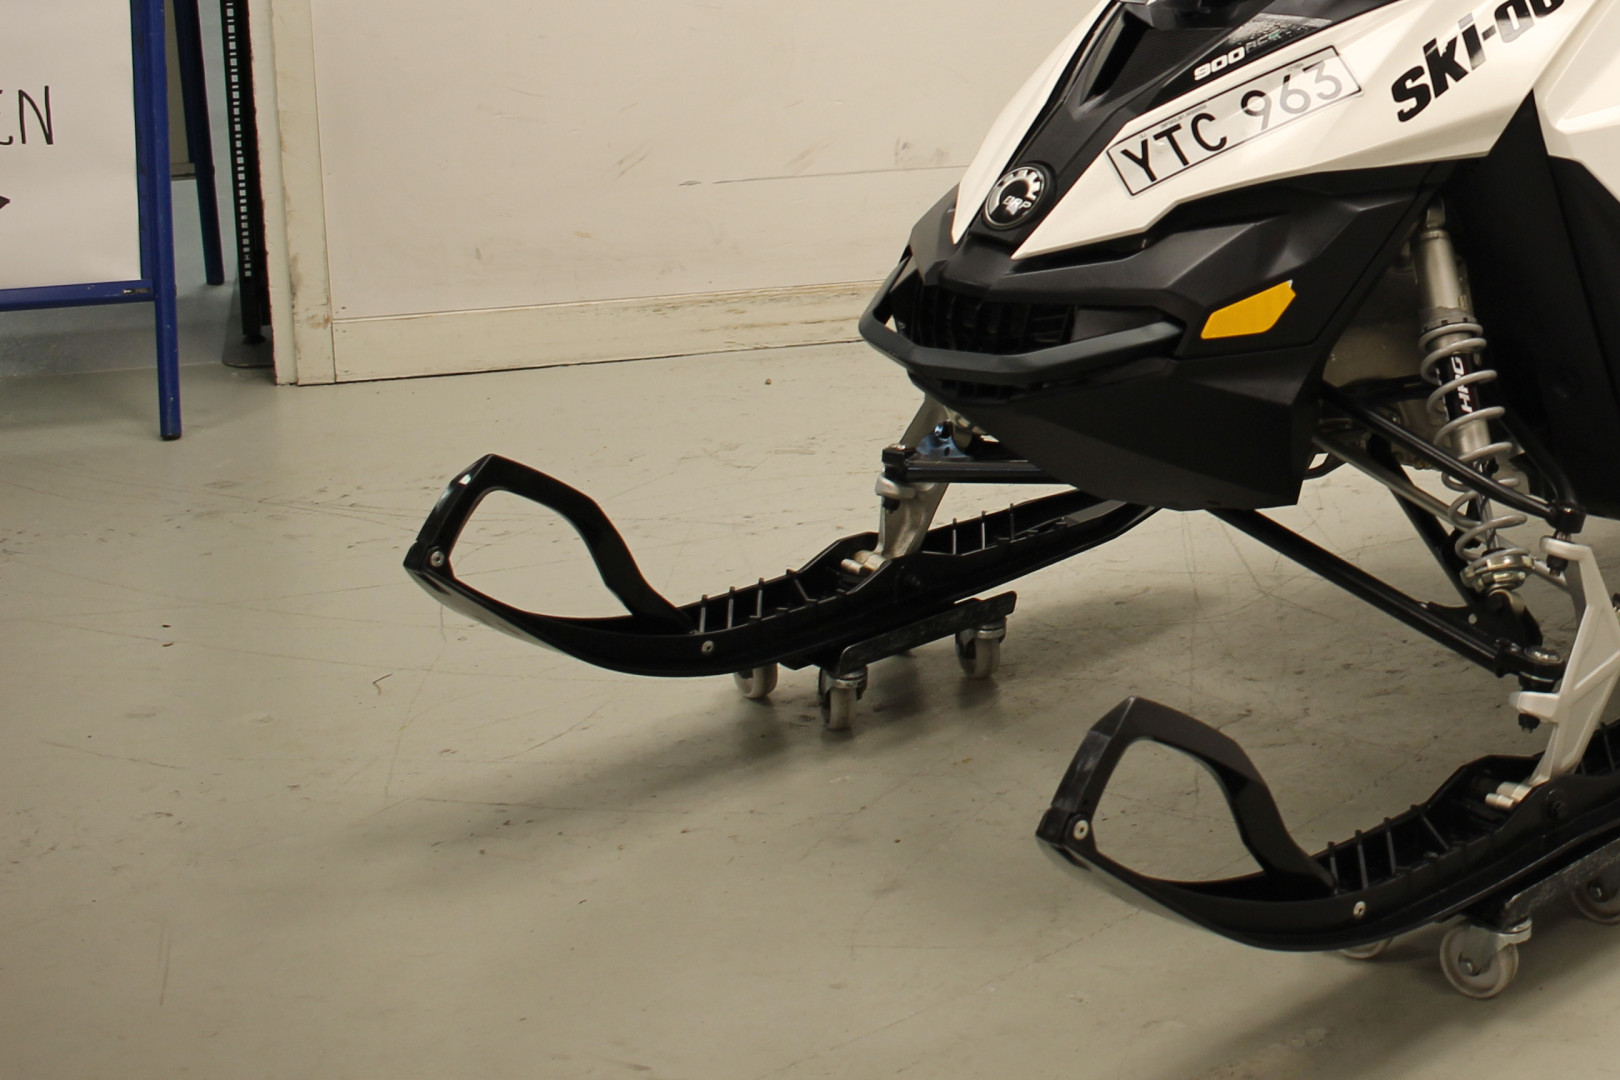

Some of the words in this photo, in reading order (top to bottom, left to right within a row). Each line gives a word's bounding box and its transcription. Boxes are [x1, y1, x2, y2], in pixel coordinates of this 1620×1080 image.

[1194, 46, 1246, 81] 900
[1120, 112, 1227, 182] YTC
[1240, 59, 1343, 131] 963
